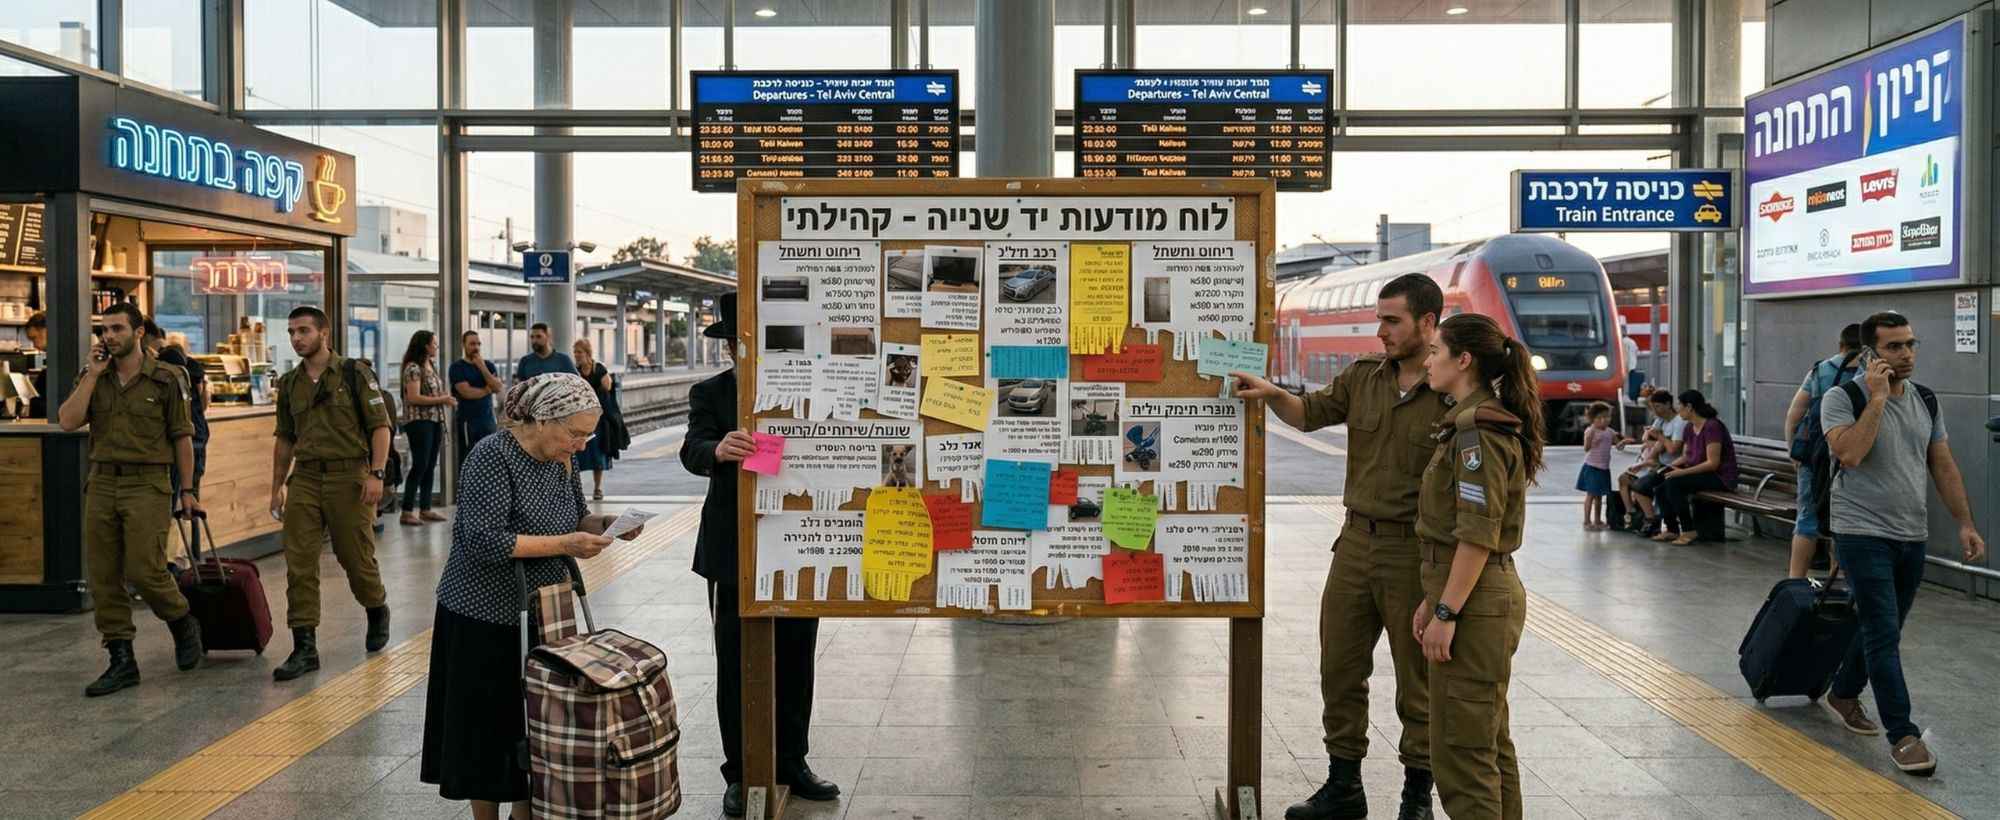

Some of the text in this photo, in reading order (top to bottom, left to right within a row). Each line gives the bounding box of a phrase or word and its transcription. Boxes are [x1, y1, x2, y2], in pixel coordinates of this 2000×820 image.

[753, 90, 807, 102] Departures
[816, 89, 831, 99] Tel
[834, 89, 856, 99] Aviv
[859, 89, 895, 99] Central
[1128, 89, 1182, 101] Departures
[1191, 89, 1206, 99] Tel
[1209, 89, 1231, 99] Aviv
[1234, 89, 1270, 99] Central
[1754, 48, 1952, 158] קניון התחנה
[116, 117, 304, 213] קפה בתחנה
[1528, 177, 1685, 201] כניסה לרכבת
[787, 203, 892, 239] קהילתי
[927, 205, 1009, 232] שנייה
[1020, 205, 1048, 232] יד
[1060, 205, 1168, 232] מודעות
[1180, 200, 1230, 232] לוח
[1556, 207, 1675, 223] Train Entrance
[1033, 247, 1057, 258] רכב
